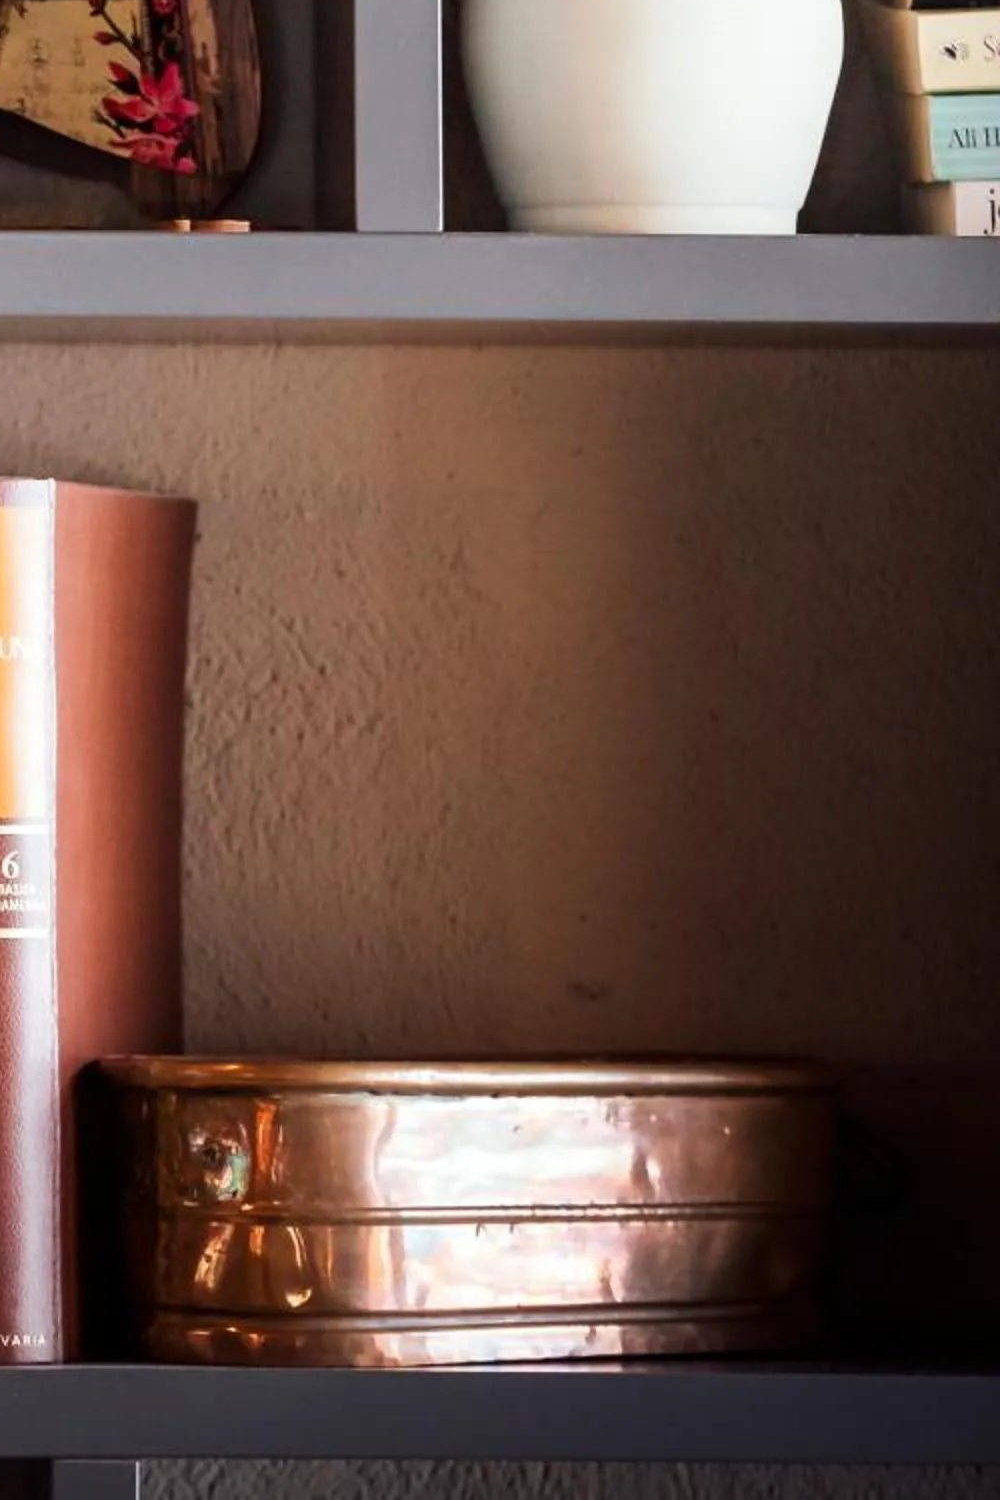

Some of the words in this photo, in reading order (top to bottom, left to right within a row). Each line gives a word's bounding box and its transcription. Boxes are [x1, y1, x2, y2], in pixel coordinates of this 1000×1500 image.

[983, 34, 1000, 62] S
[983, 188, 1000, 235] j
[1, 851, 20, 879] 6
